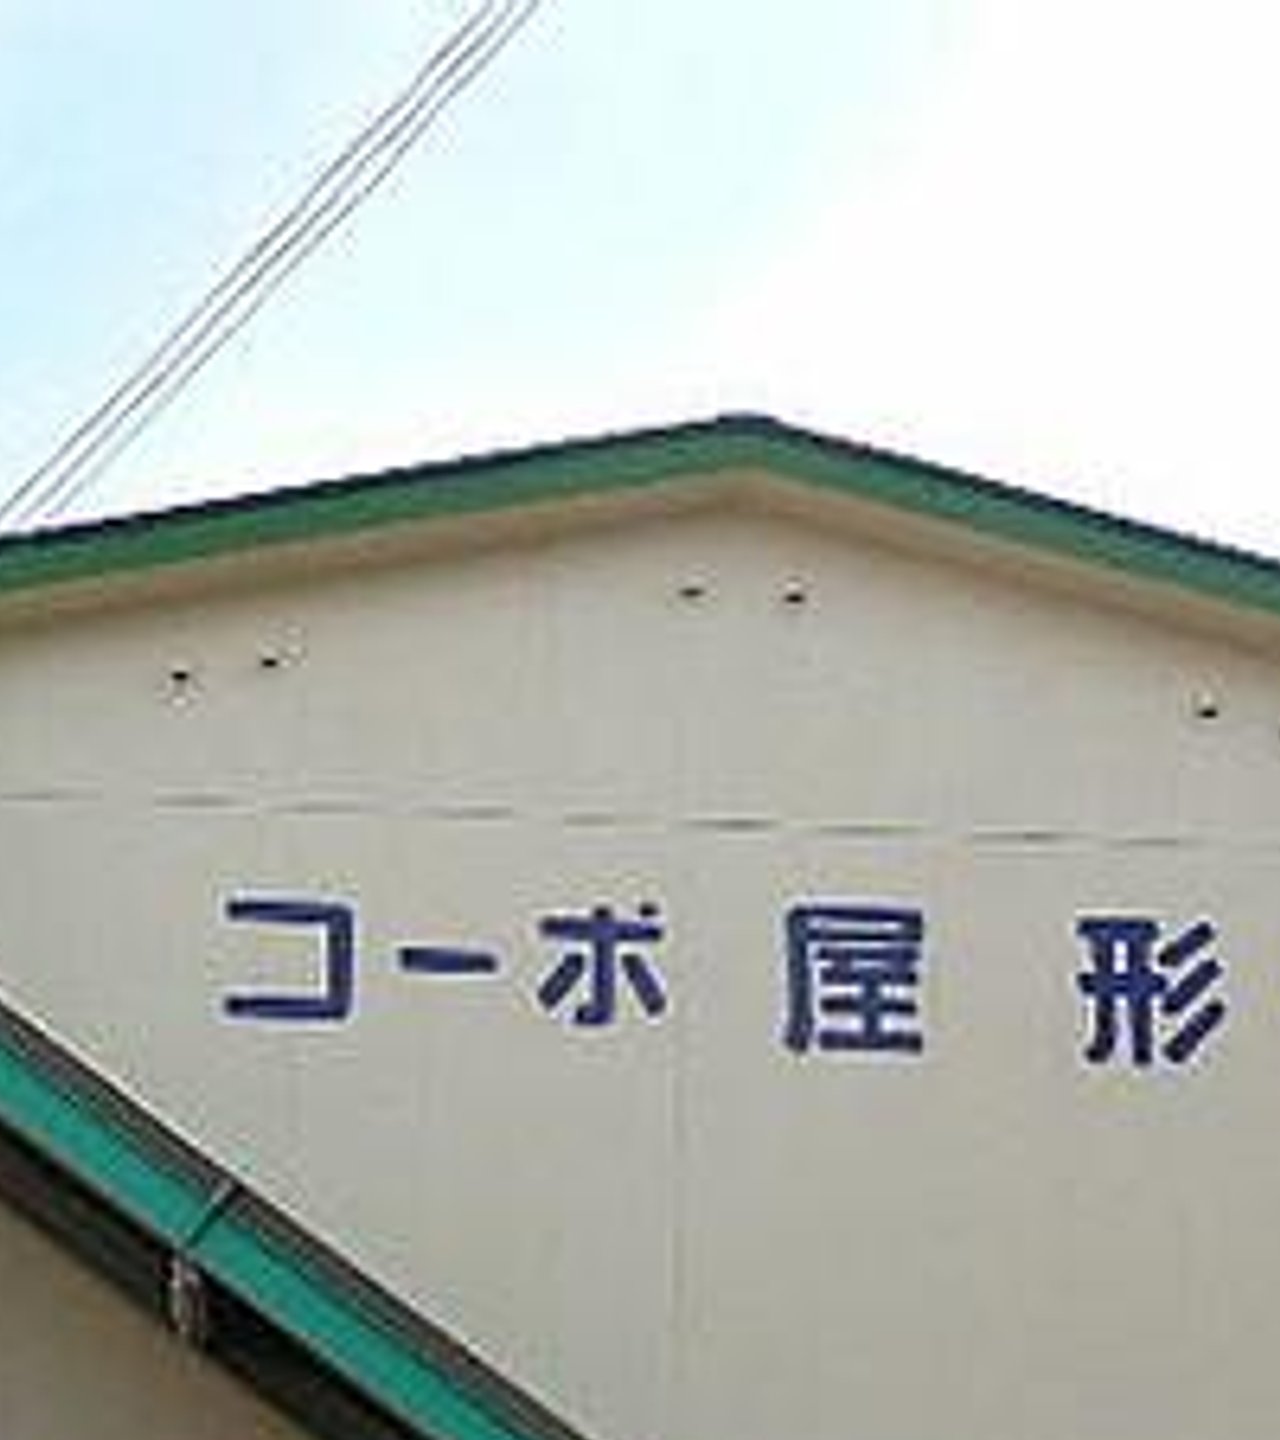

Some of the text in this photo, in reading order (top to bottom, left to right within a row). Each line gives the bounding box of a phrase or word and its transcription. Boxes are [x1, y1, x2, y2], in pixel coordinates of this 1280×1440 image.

[224, 899, 1226, 1064] コーポ屋形
